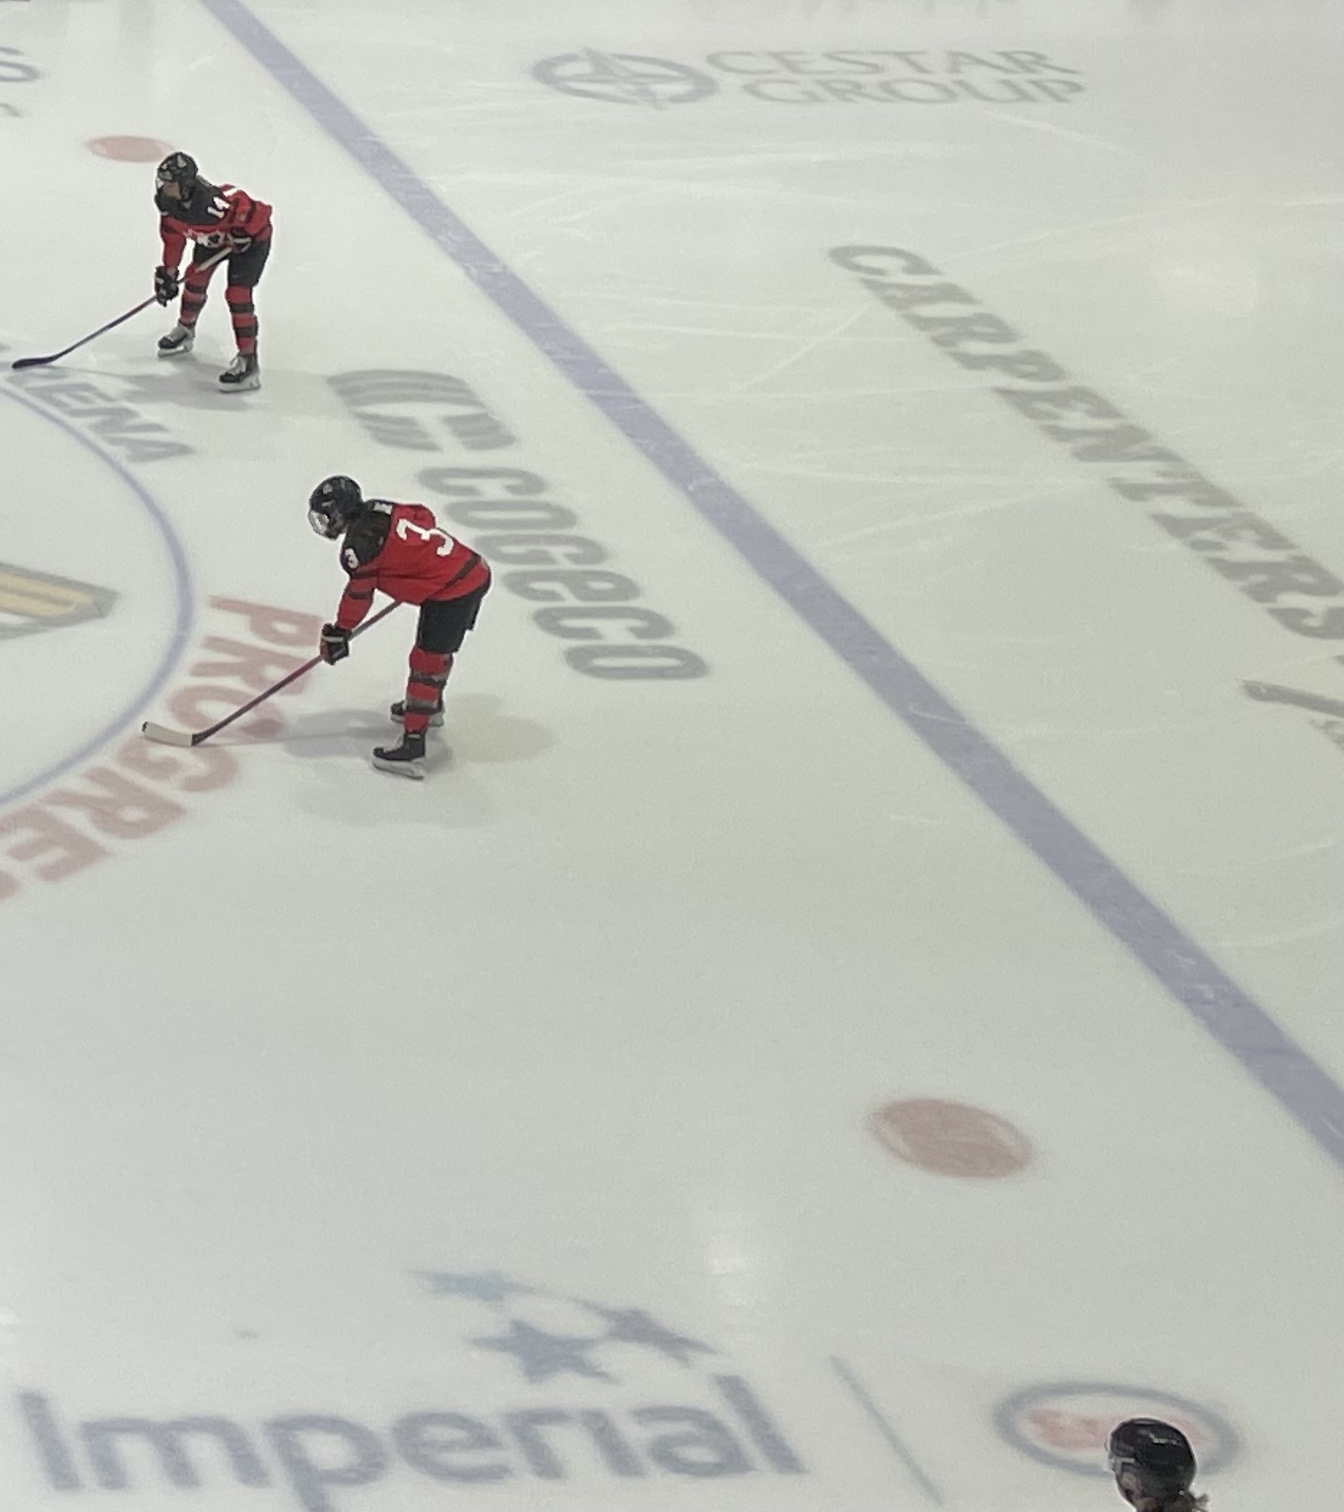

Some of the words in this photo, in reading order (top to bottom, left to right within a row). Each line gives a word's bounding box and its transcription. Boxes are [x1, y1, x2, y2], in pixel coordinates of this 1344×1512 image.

[703, 48, 1068, 78] CESTAR
[740, 77, 1090, 106] GROUP
[395, 516, 453, 557] 3
[16, 1372, 813, 1512] Imperial
